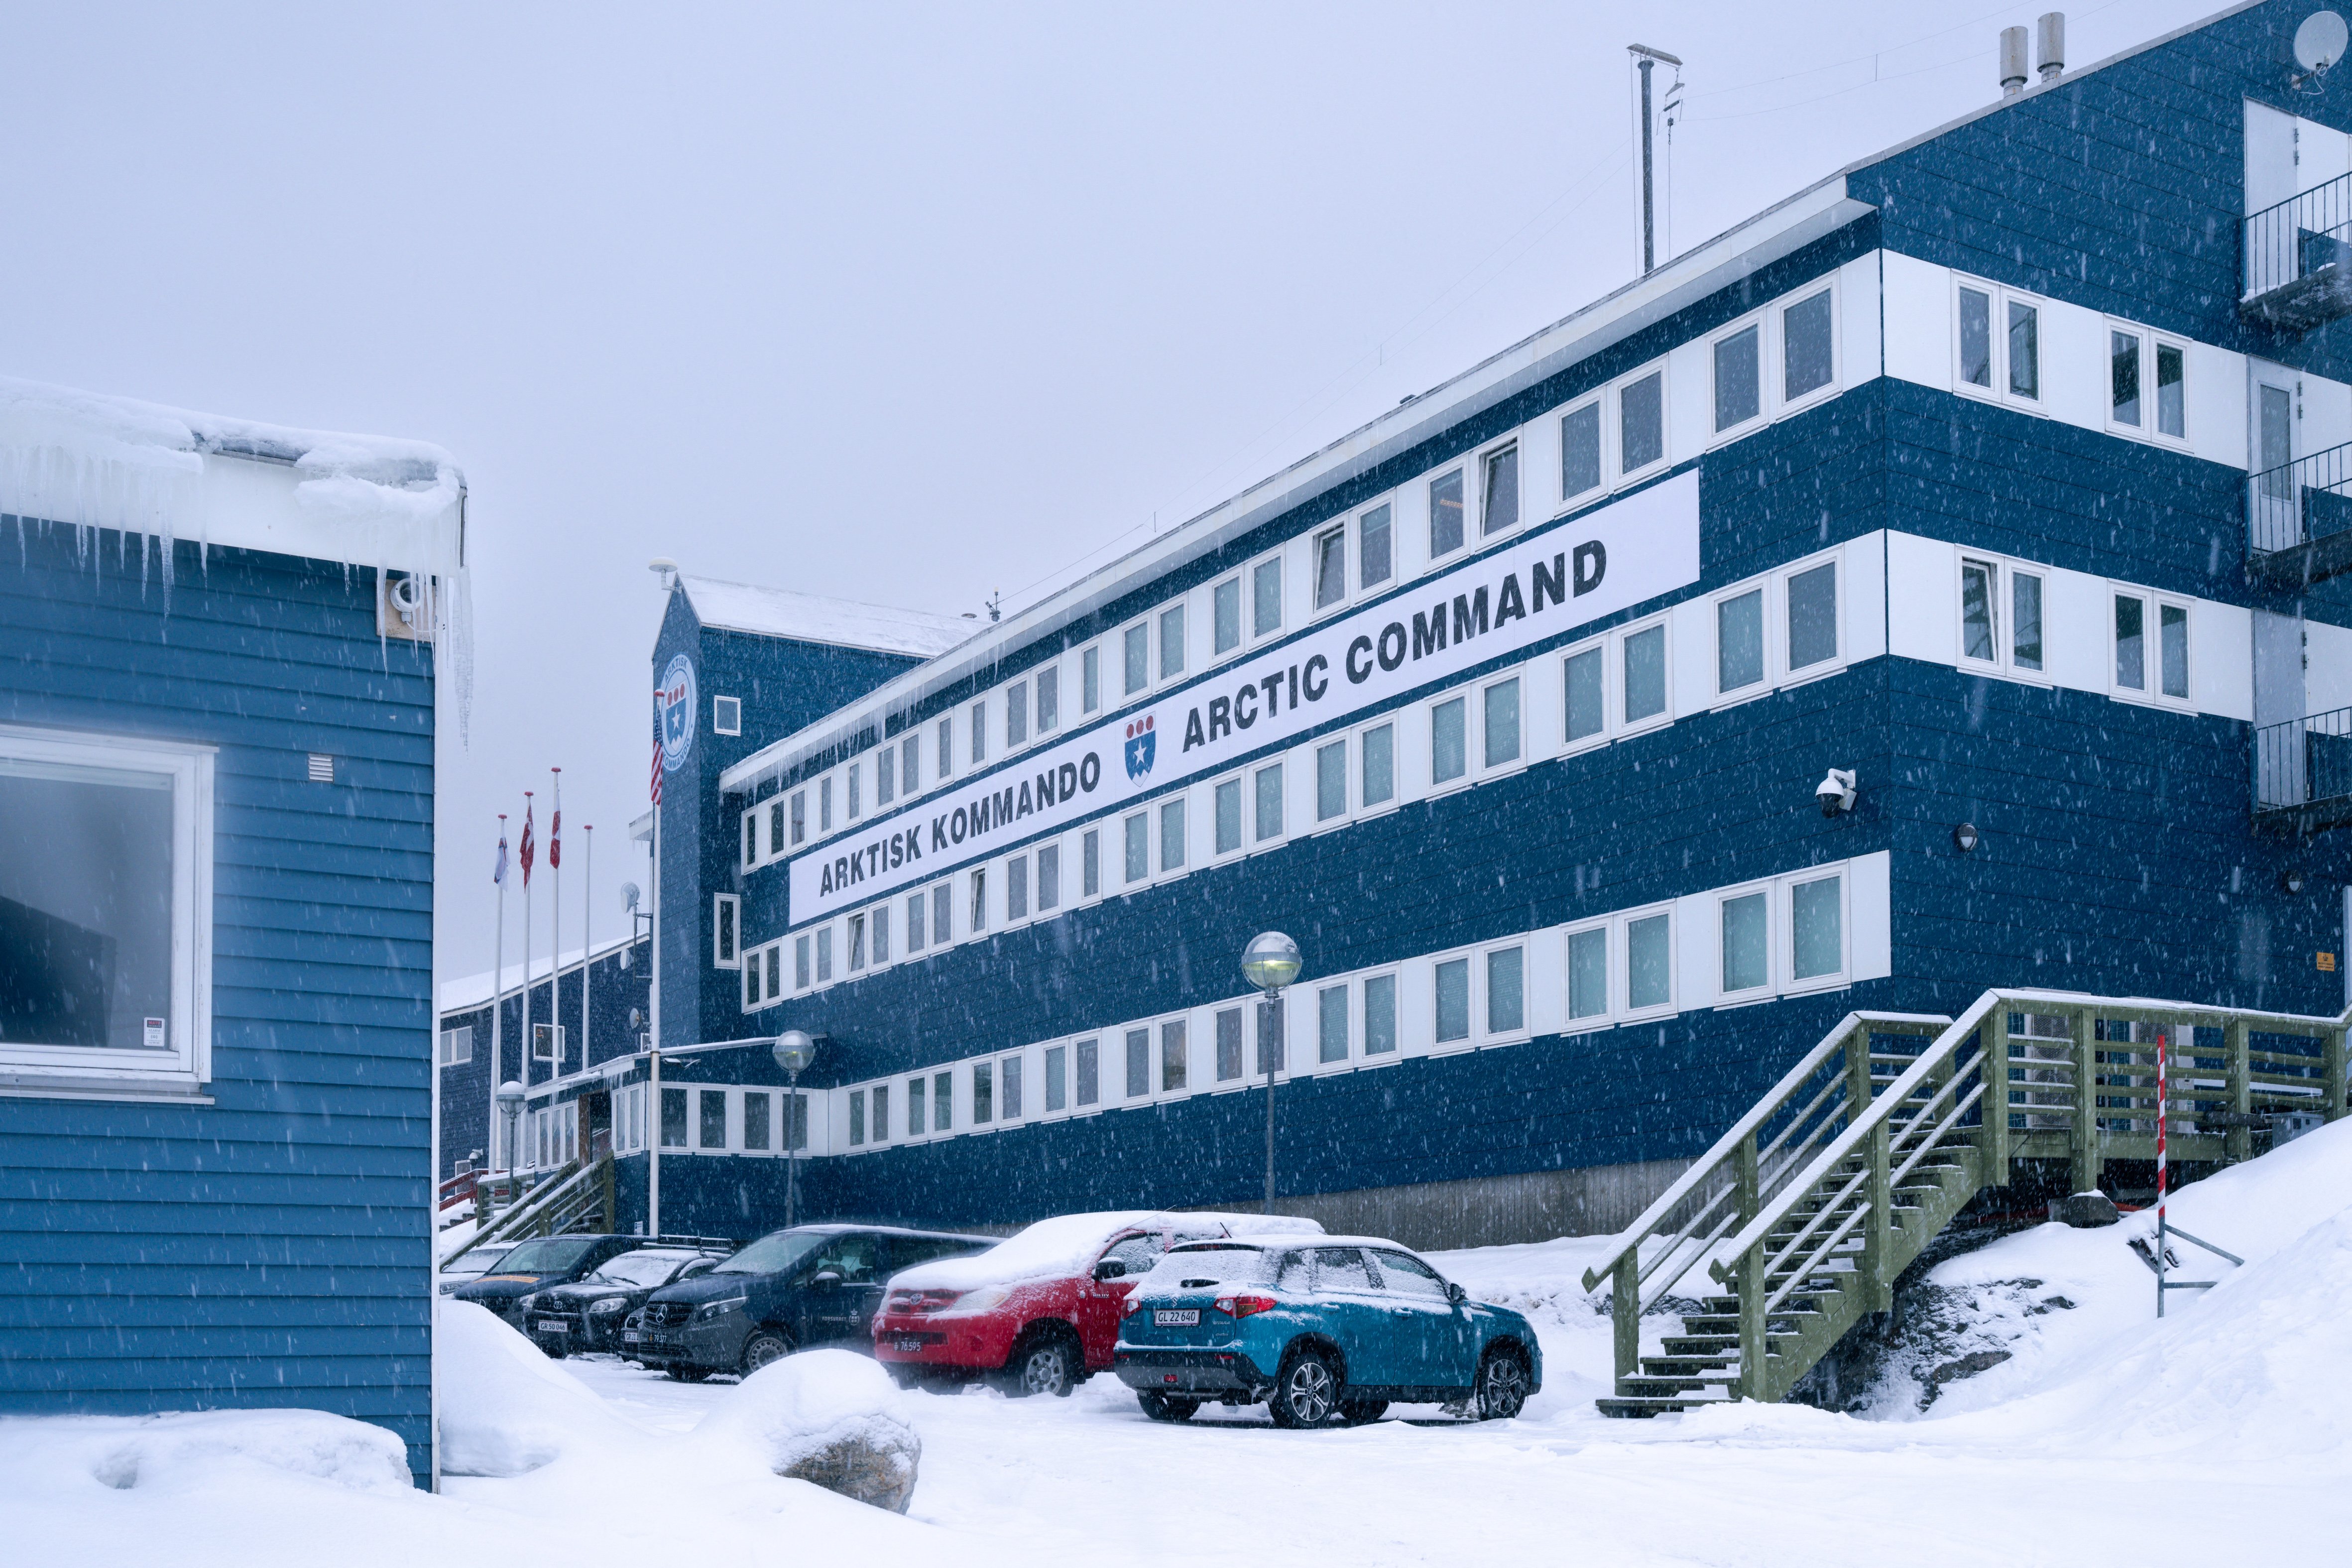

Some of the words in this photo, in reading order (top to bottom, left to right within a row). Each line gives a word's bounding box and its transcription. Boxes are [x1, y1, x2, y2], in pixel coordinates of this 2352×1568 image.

[1183, 655, 1328, 753] ARCTIC
[1346, 540, 1607, 684] COMMAND
[665, 657, 688, 684] ARKTISK
[663, 737, 690, 769] KOMMANDO
[820, 824, 922, 897] ARKTISK
[933, 752, 1101, 853] KOMMANDO
[1158, 1312, 1168, 1322] GL
[1170, 1312, 1179, 1322] 22
[1181, 1312, 1195, 1322] 640
[901, 1341, 921, 1351] 76.595
